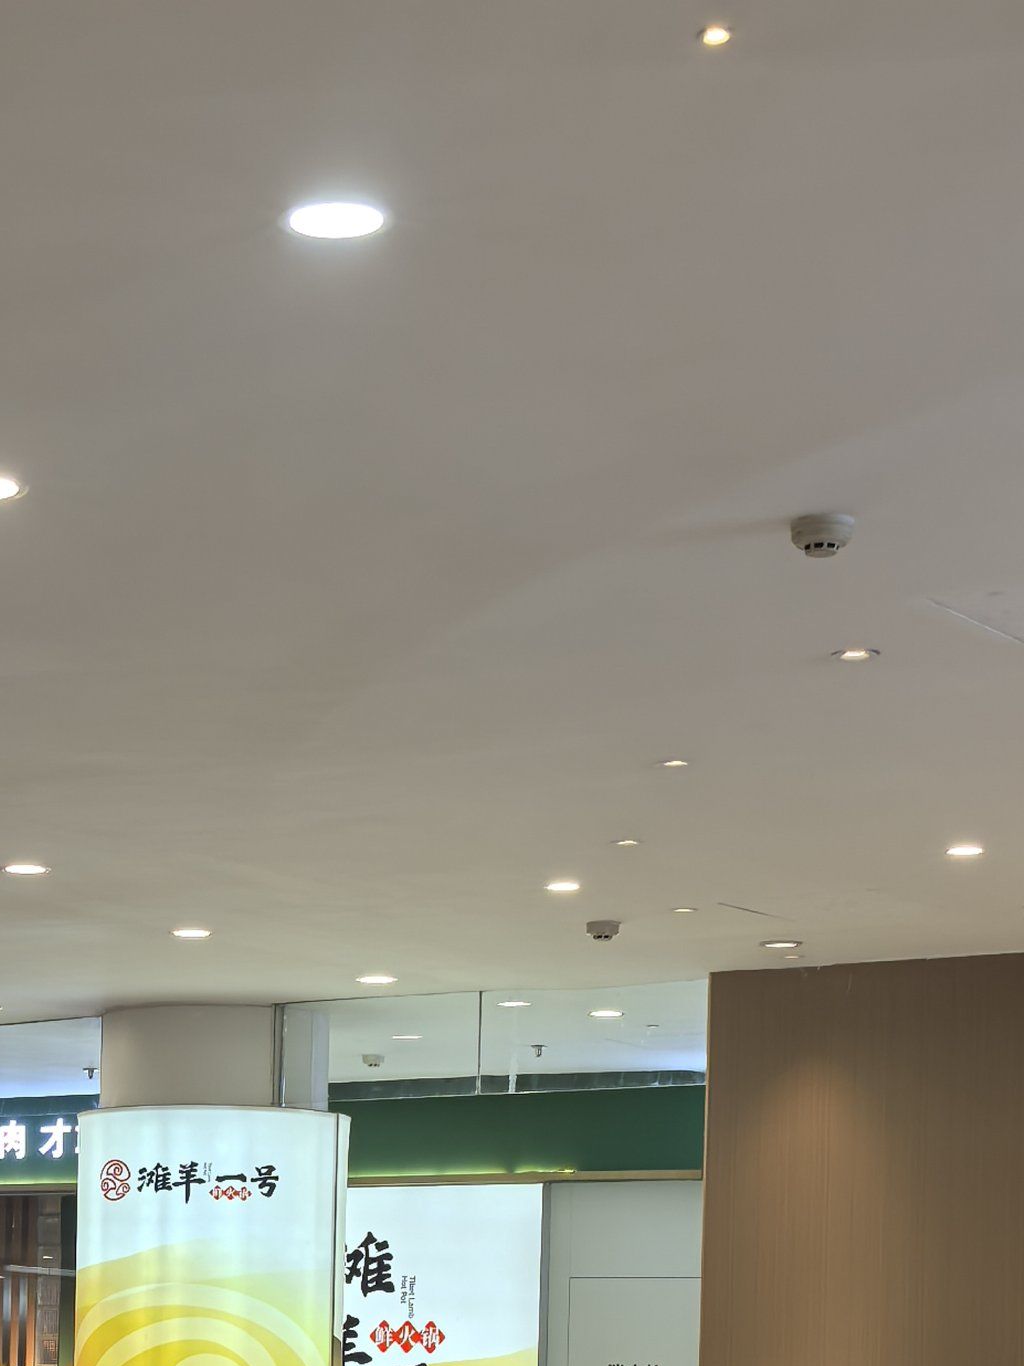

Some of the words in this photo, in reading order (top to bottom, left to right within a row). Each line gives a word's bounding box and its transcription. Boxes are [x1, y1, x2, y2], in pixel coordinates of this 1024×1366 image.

[38, 1117, 79, 1159] 才
[137, 1160, 280, 1204] 滩羊一号
